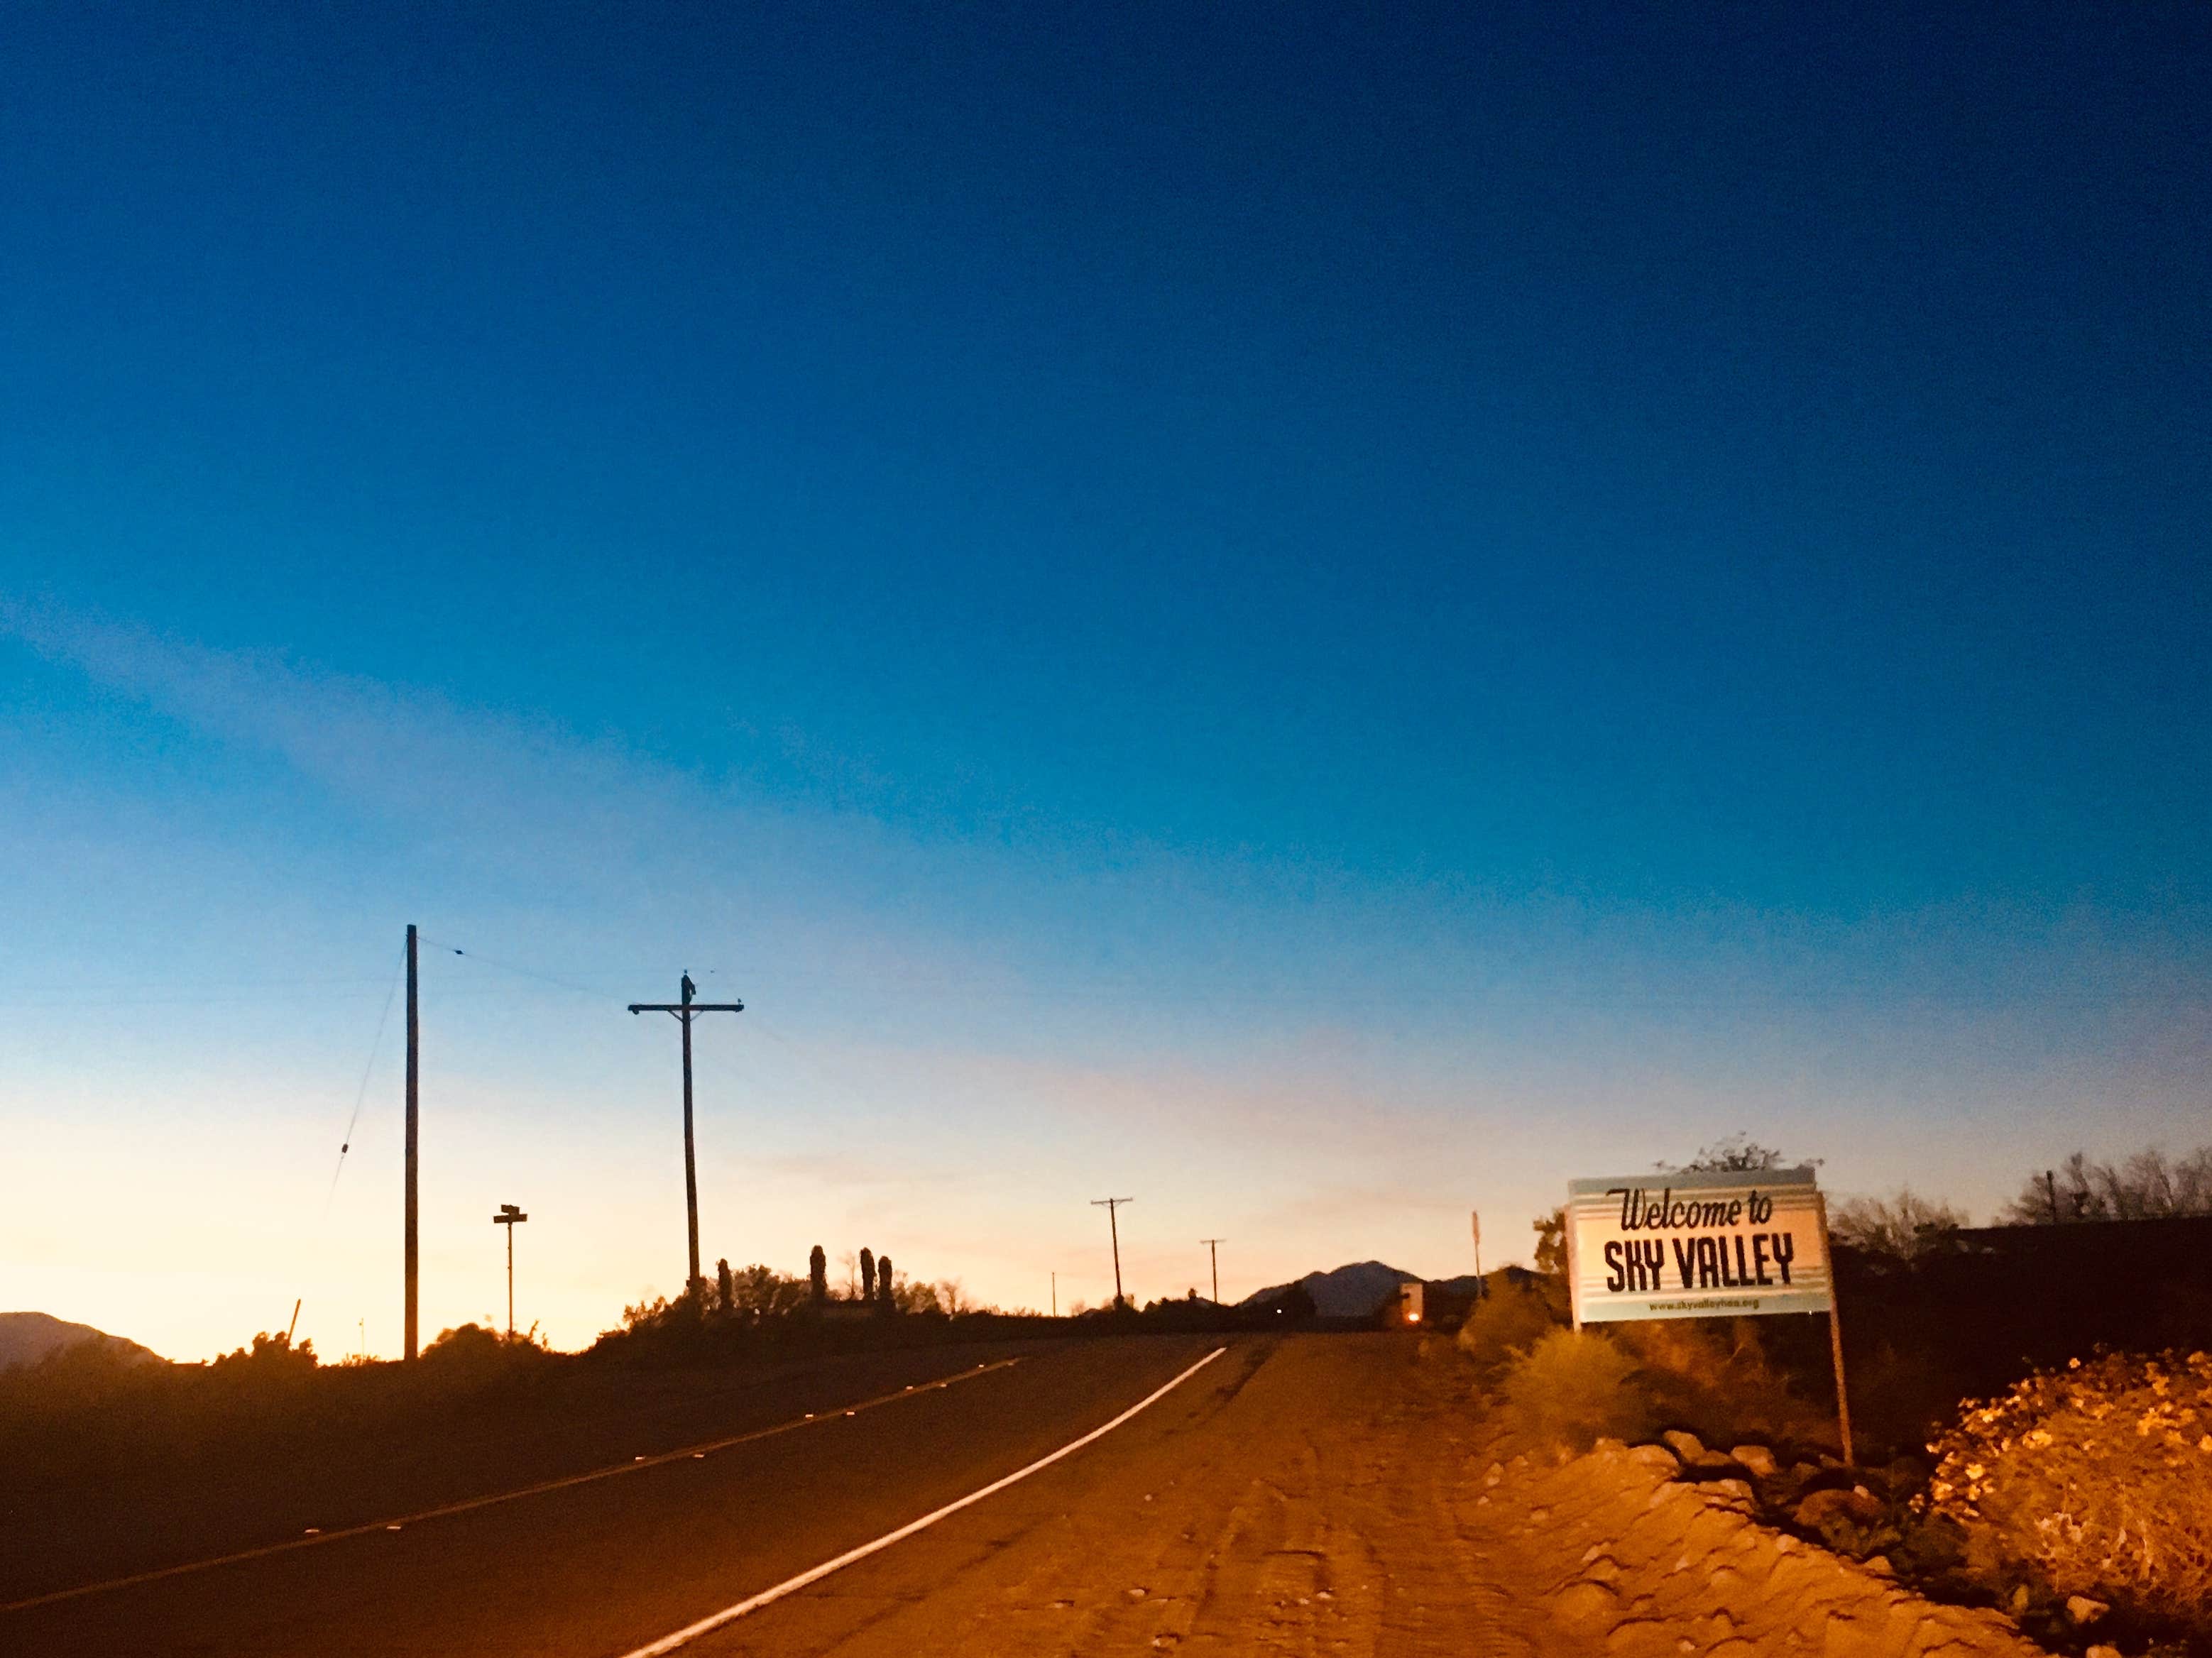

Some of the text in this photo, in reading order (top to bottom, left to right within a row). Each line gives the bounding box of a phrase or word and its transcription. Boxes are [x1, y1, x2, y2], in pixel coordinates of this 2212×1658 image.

[1606, 1187, 1773, 1231] Welcome to
[1604, 1233, 1794, 1292] SKY VALLEY
